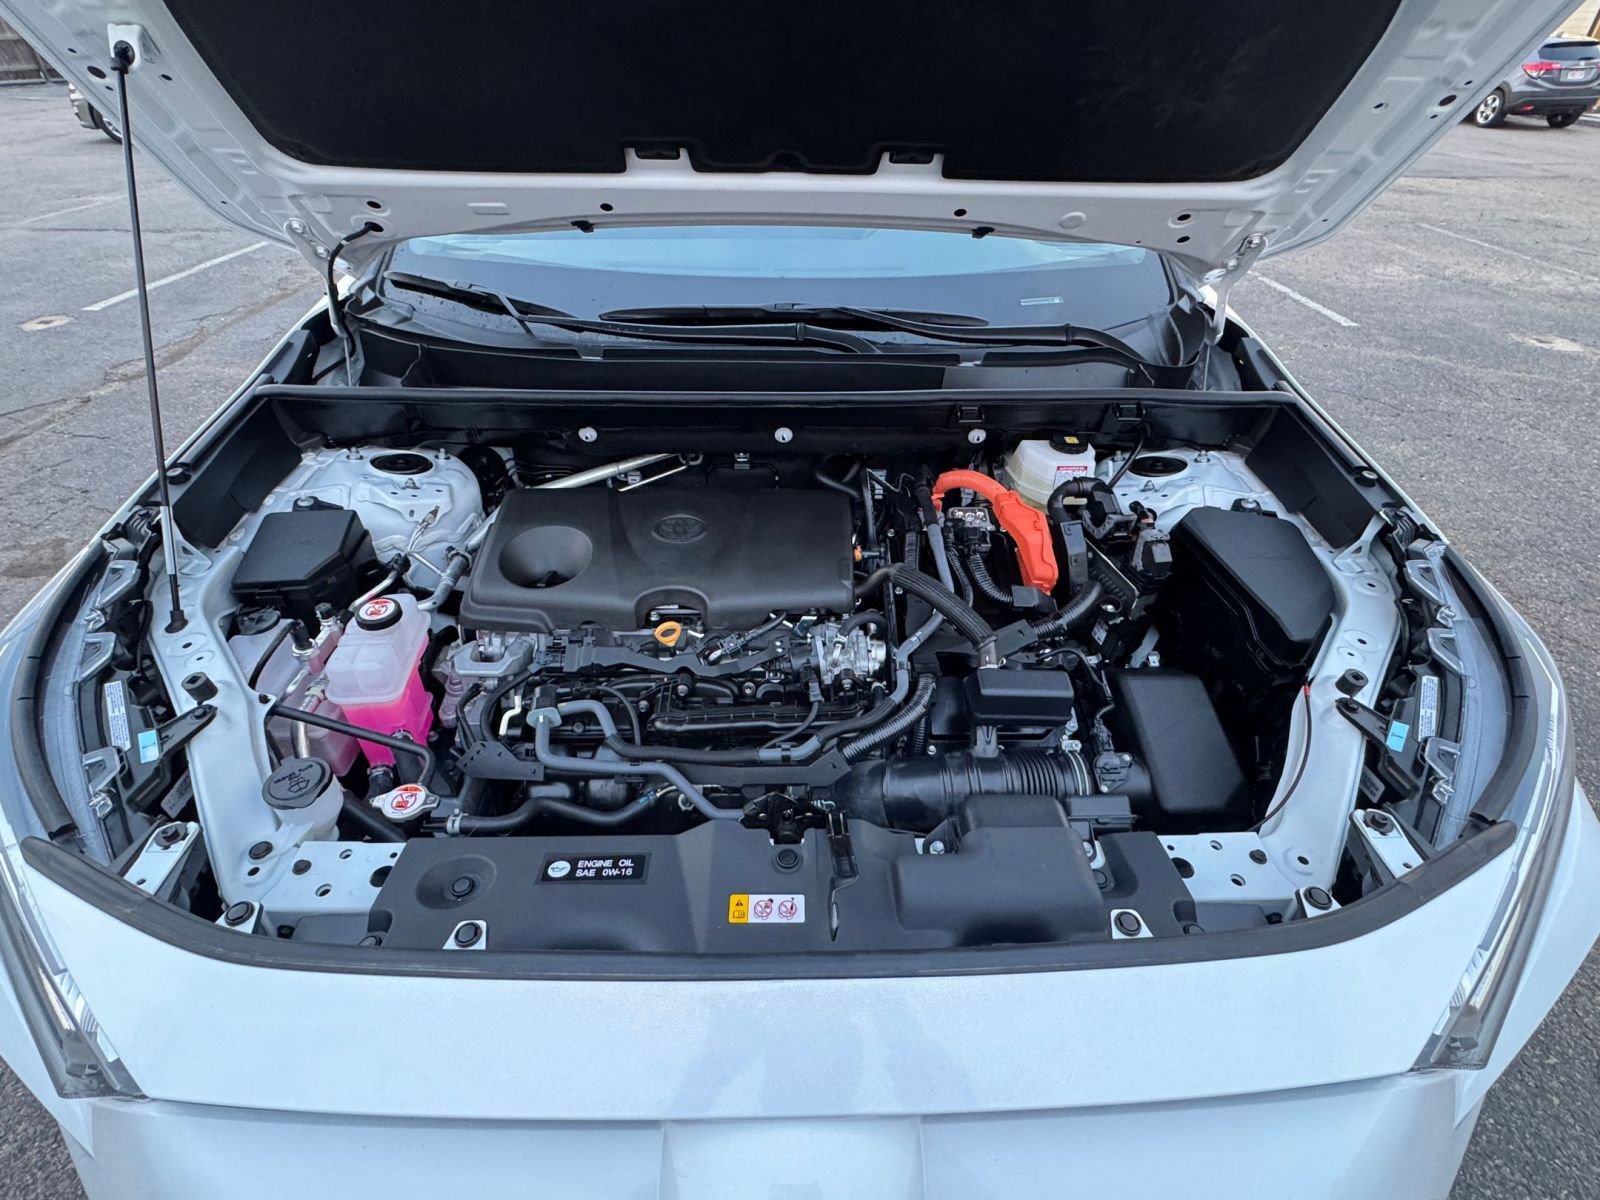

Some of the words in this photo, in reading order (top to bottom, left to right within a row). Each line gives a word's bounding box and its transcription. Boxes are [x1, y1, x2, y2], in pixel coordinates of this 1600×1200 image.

[577, 859, 613, 868] ENGINE
[618, 859, 635, 867] OIL
[575, 868, 597, 877] SAE
[602, 868, 633, 876] 0W-16
